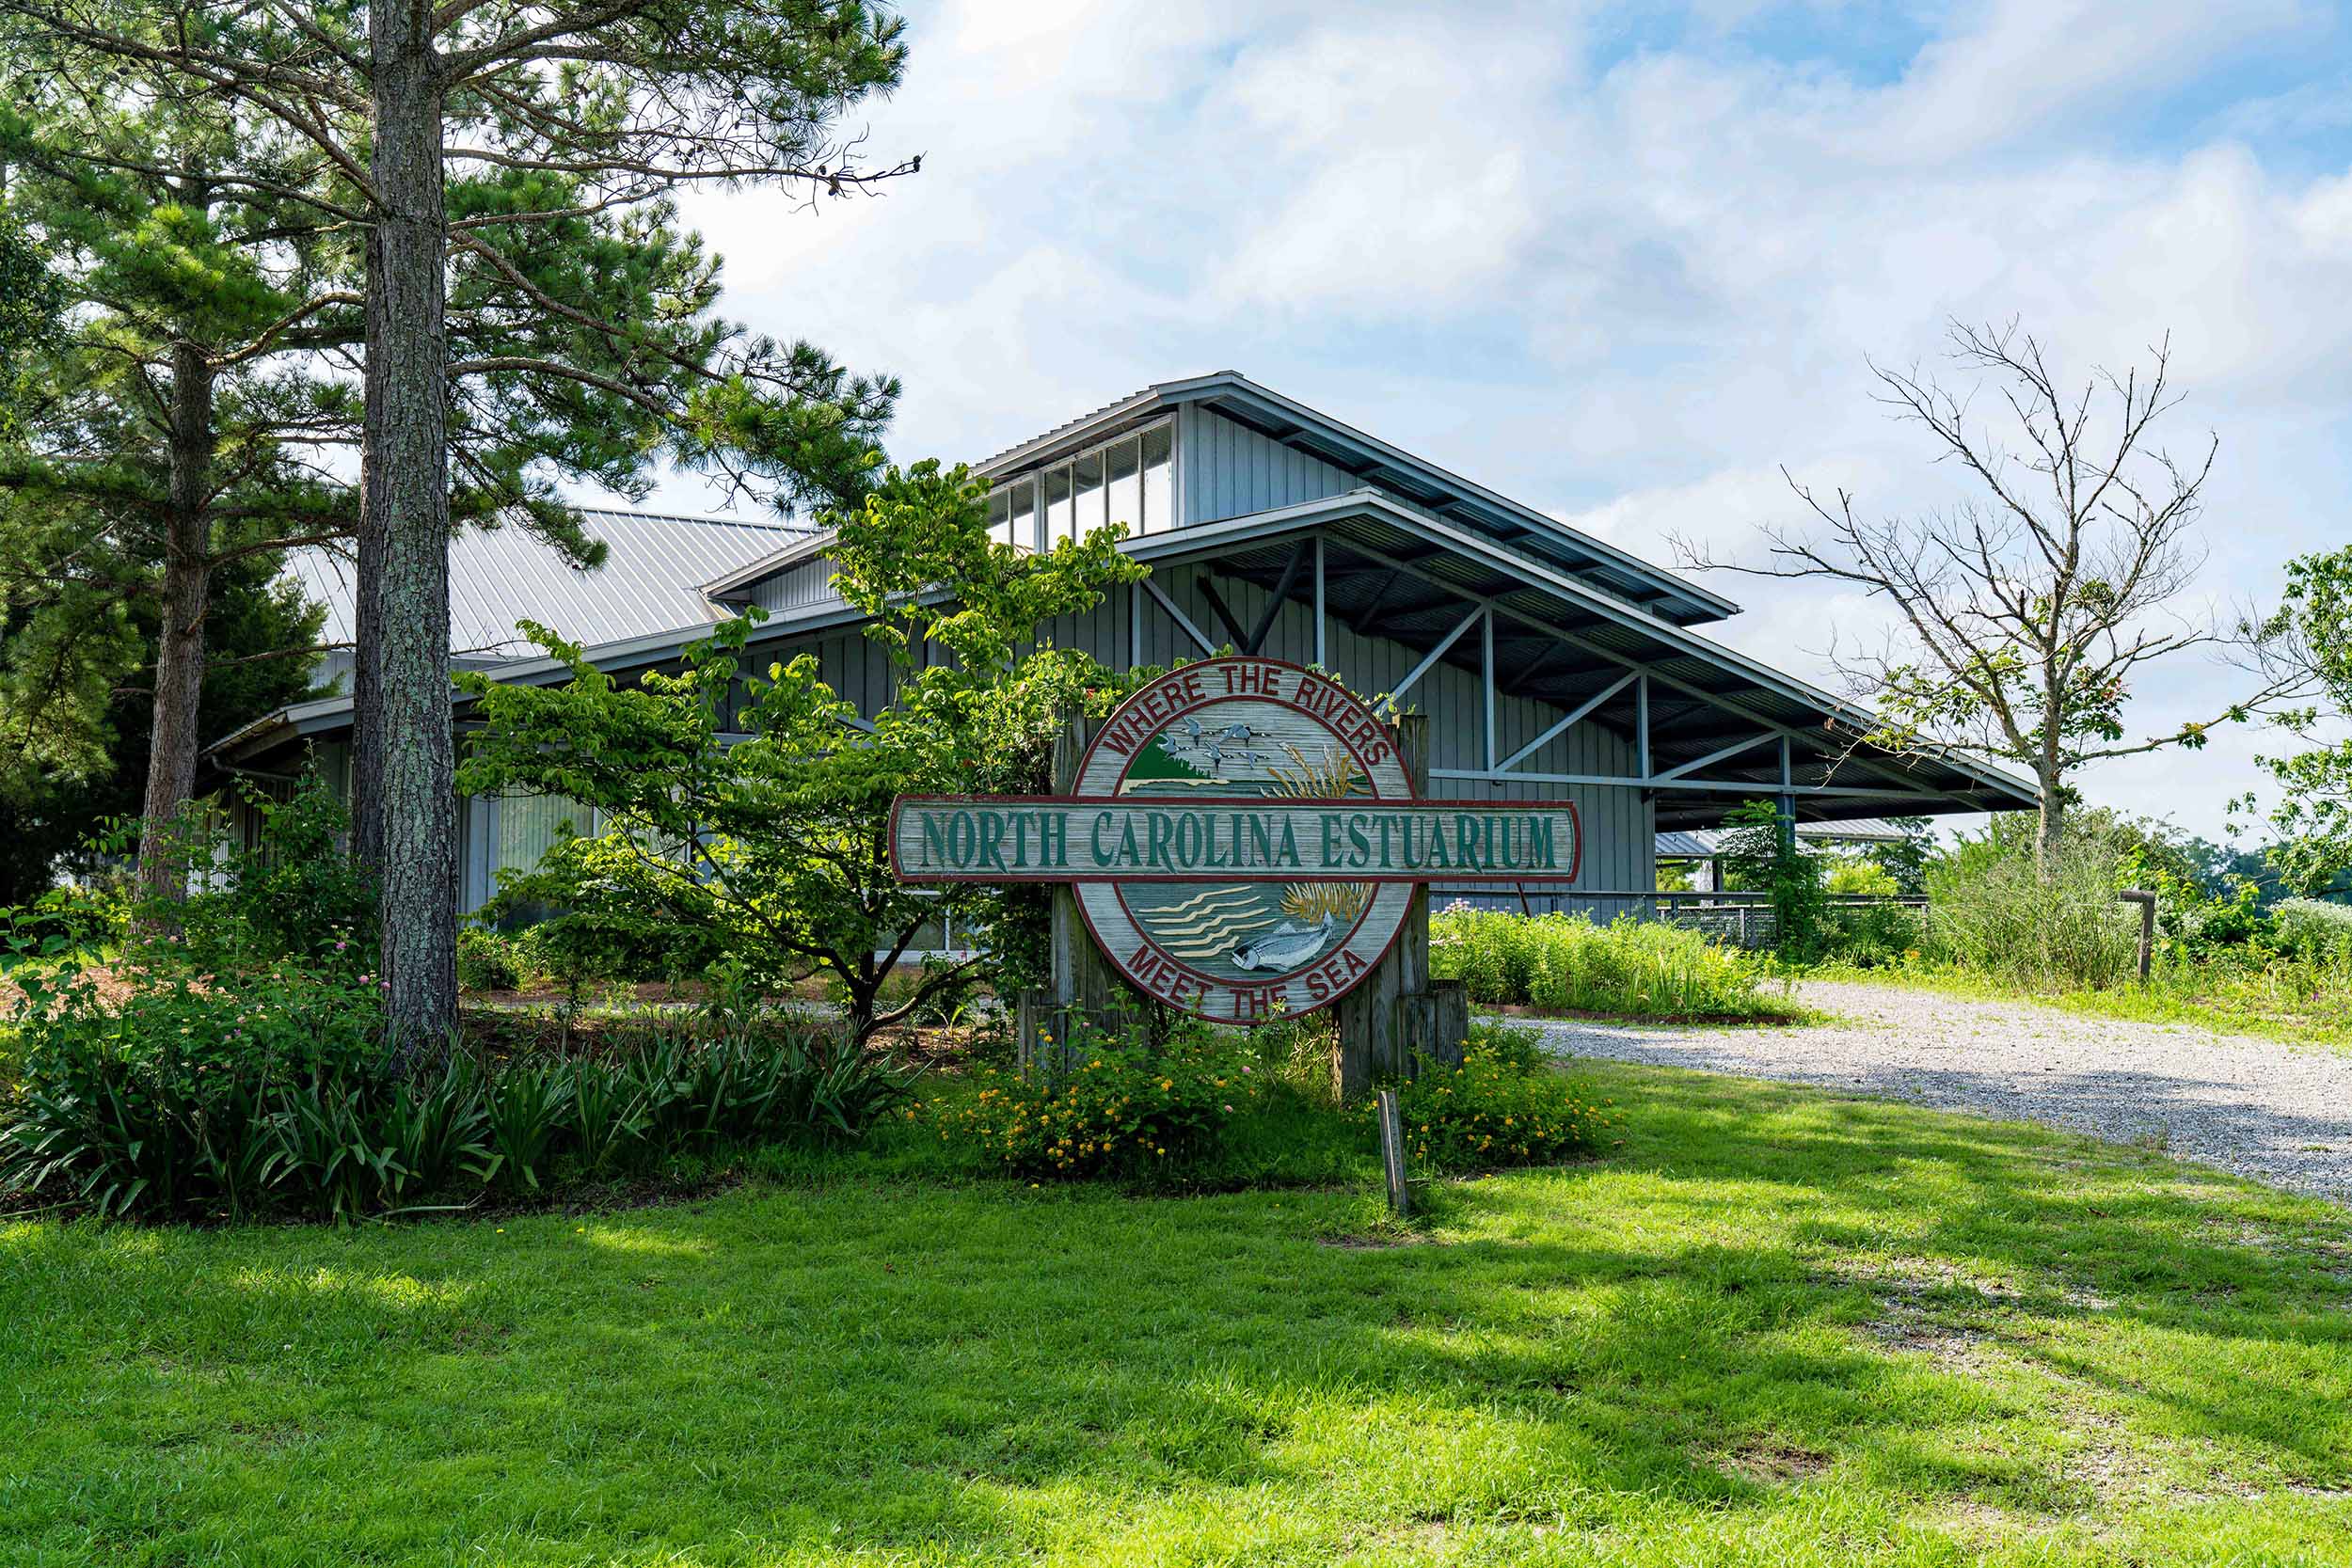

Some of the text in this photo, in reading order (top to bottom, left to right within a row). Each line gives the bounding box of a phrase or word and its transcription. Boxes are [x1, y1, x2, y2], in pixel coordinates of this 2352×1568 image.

[1103, 665, 1390, 767] WHERE THE RIVERS
[919, 810, 1558, 875] NORTH CAROLINA ESTUARIUM
[1127, 943, 1368, 1017] MEET THE SEA
